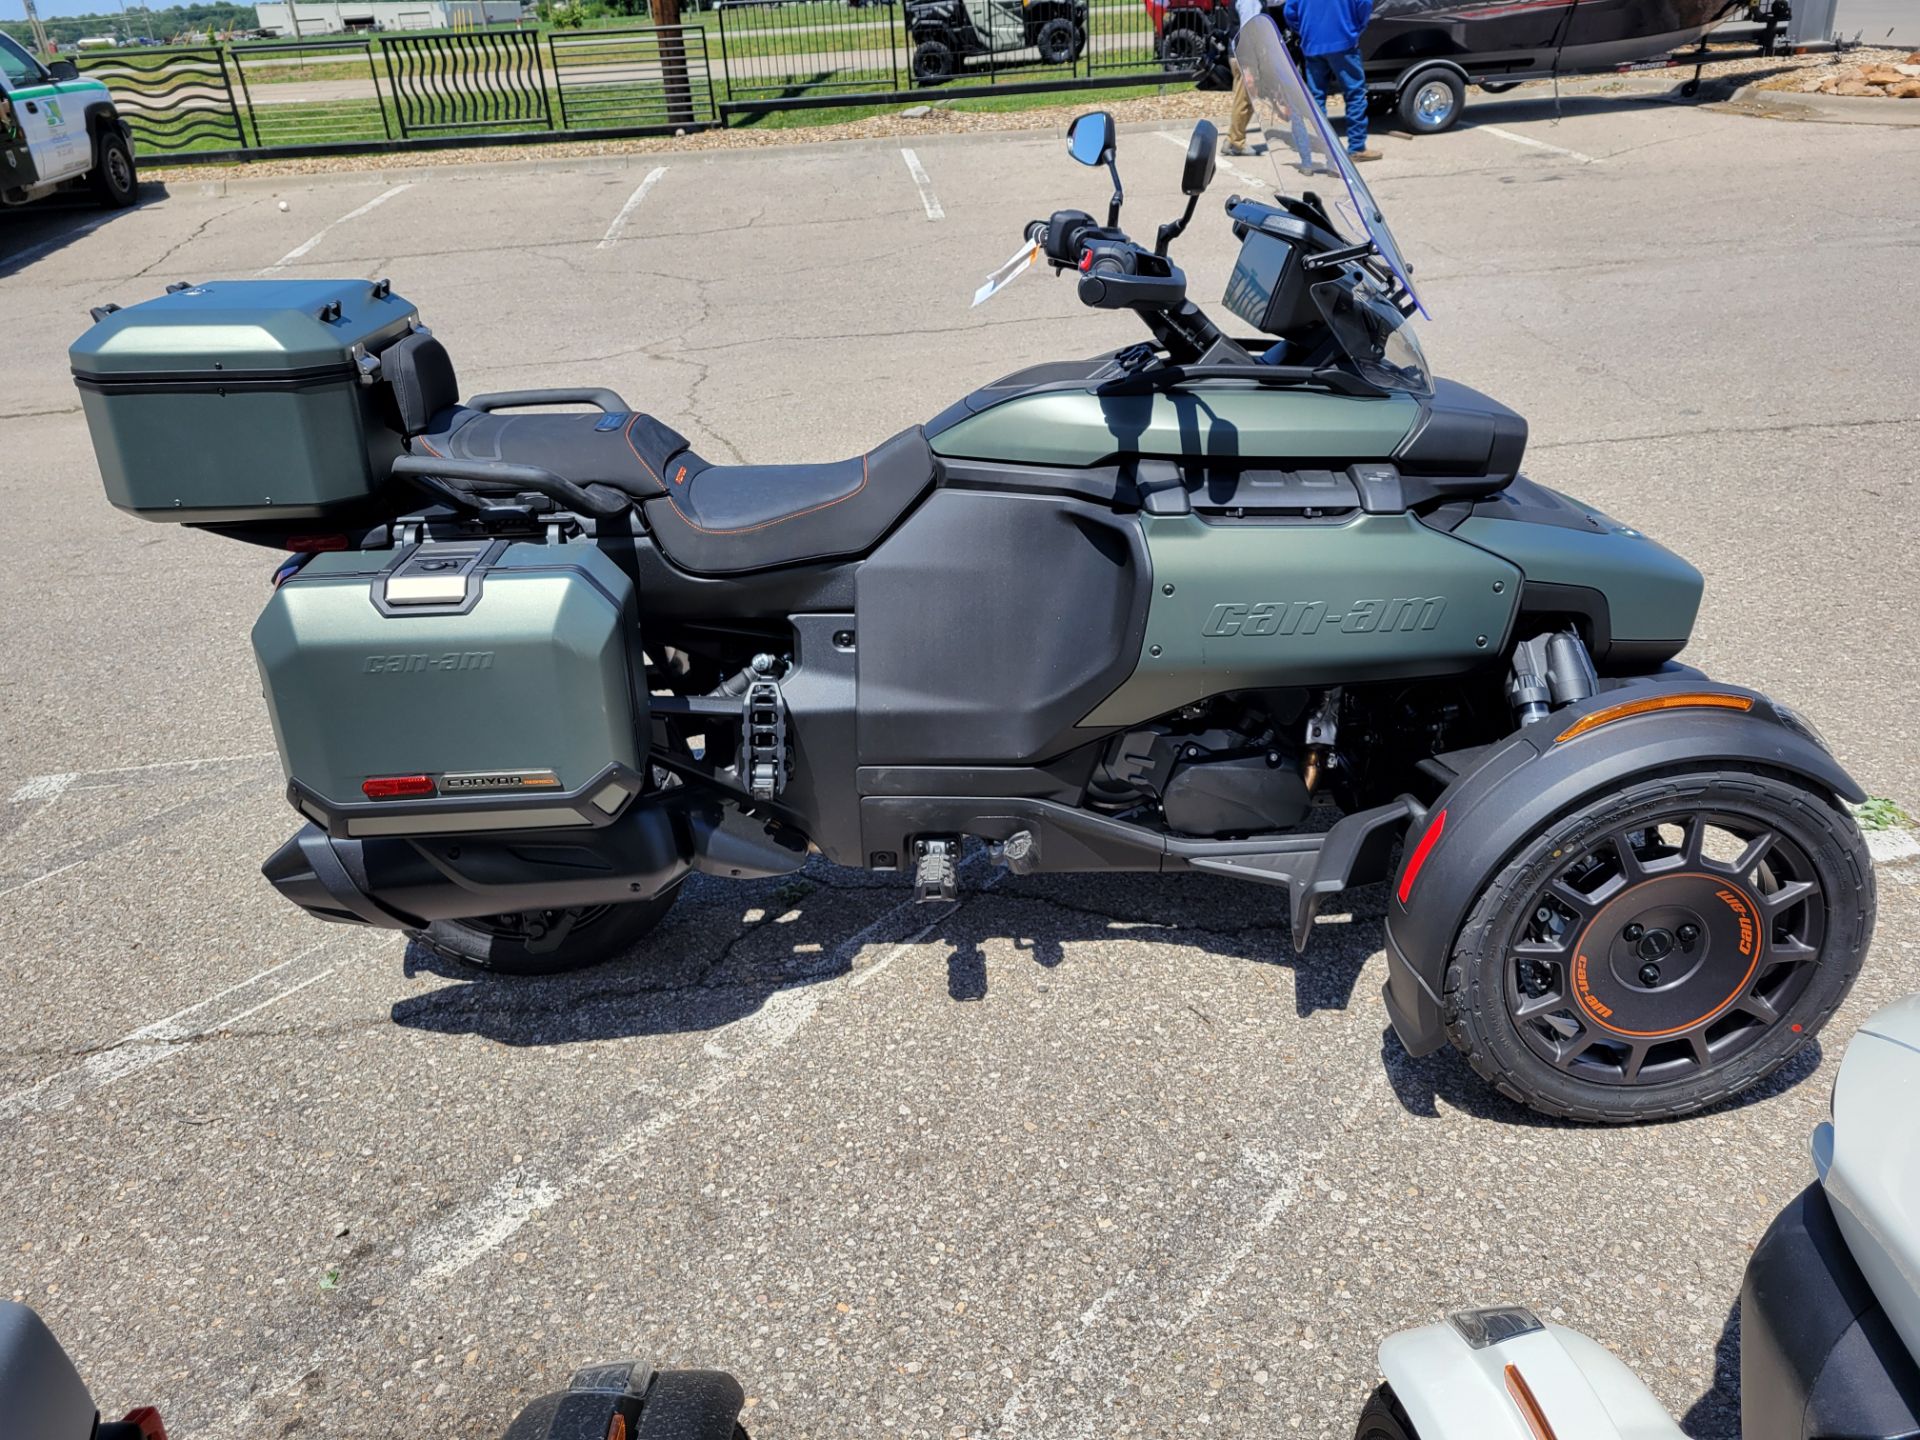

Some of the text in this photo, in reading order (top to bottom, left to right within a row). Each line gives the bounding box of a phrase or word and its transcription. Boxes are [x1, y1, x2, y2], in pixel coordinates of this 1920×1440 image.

[1631, 60, 1668, 71] TRACKER
[1201, 597, 1448, 637] can-am
[363, 652, 494, 674] can-am
[1715, 890, 1753, 955] can-am
[1578, 955, 1613, 1018] can-am
